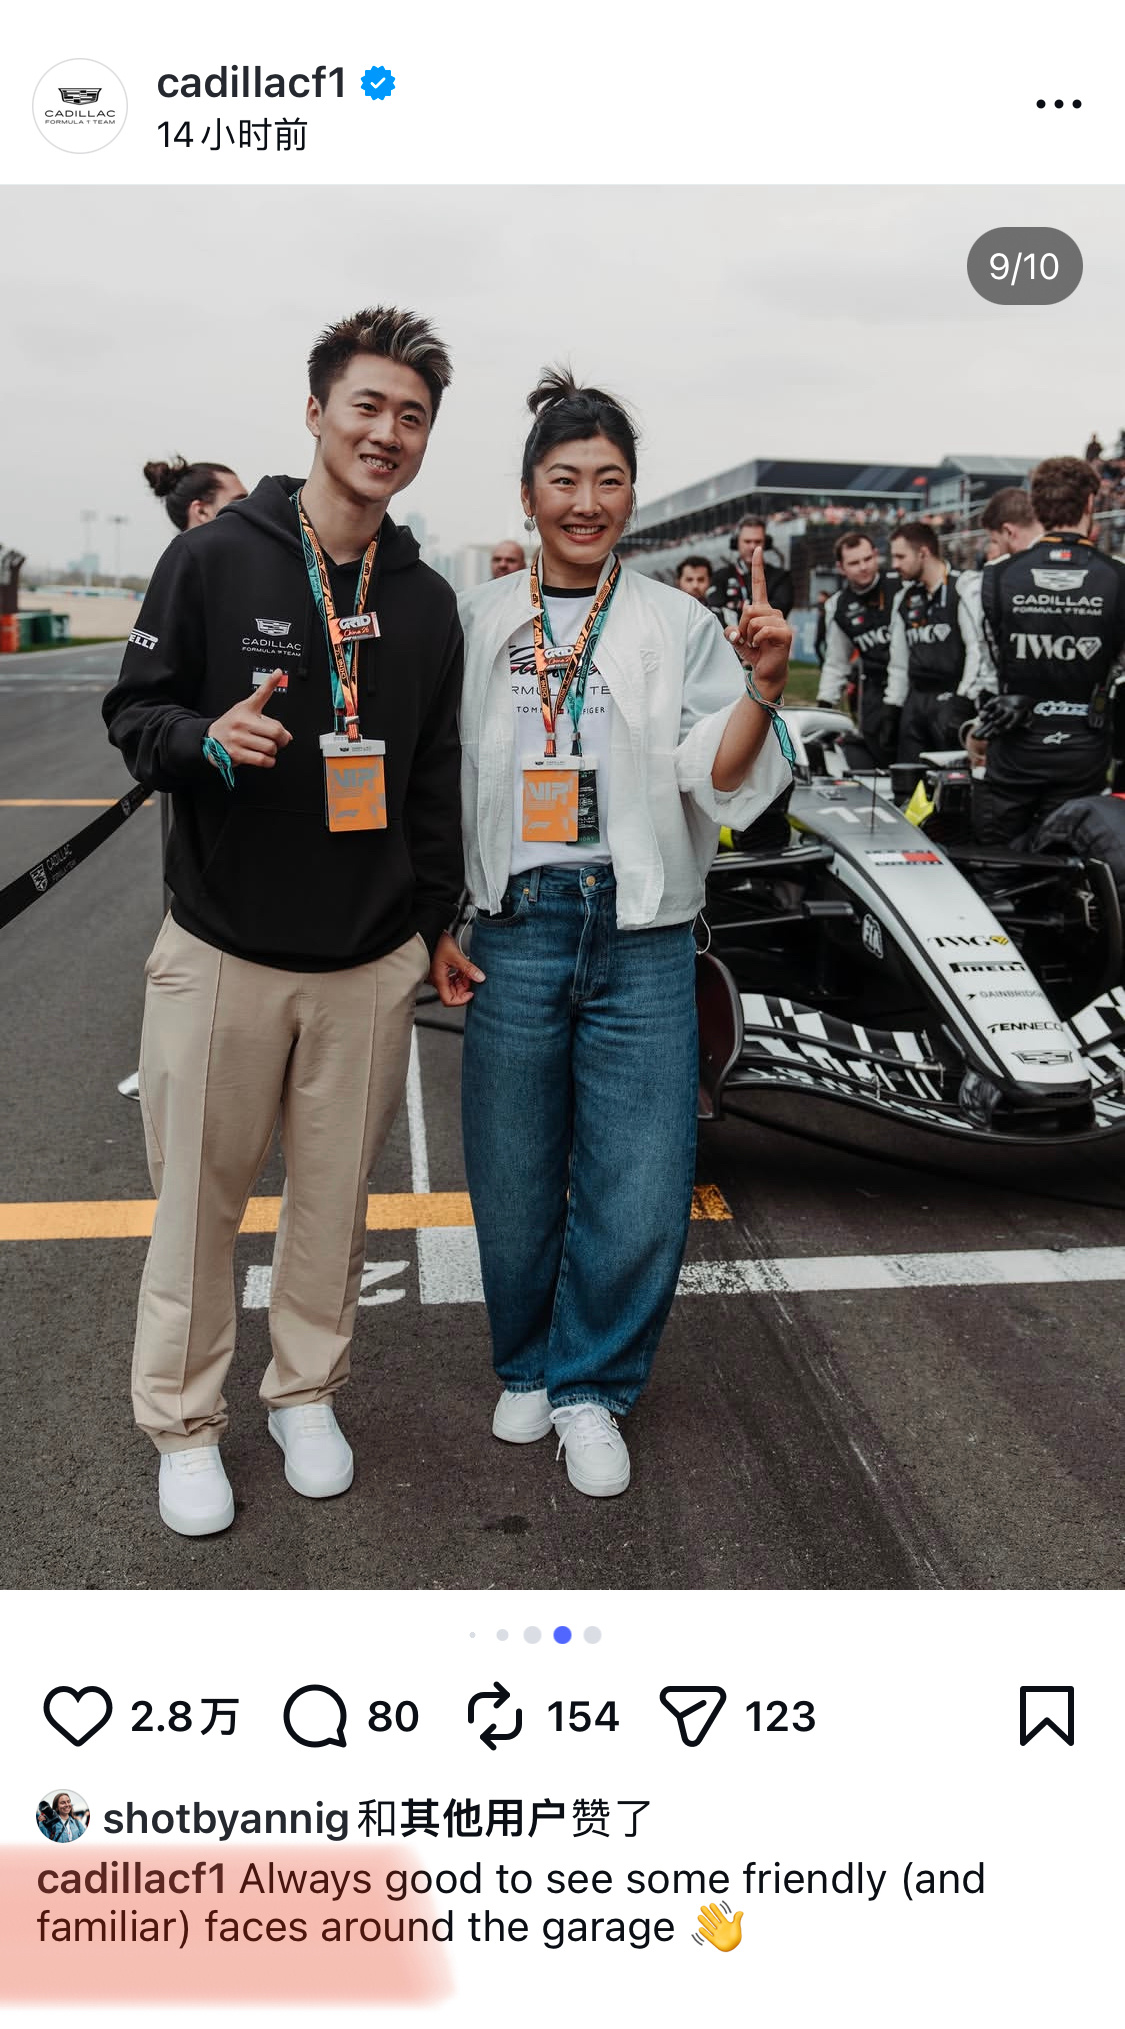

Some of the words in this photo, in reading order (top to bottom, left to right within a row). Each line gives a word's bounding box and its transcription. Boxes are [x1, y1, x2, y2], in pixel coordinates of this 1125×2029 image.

[1012, 594, 1104, 607] CADILLAC
[1012, 606, 1063, 615] FORMULA
[1073, 608, 1103, 616] TEAM
[242, 637, 302, 651] CADILLAC
[1009, 632, 1077, 661] TWG
[333, 767, 375, 788] VIP
[528, 782, 568, 801] VIP
[949, 961, 1026, 974] PIRELLI
